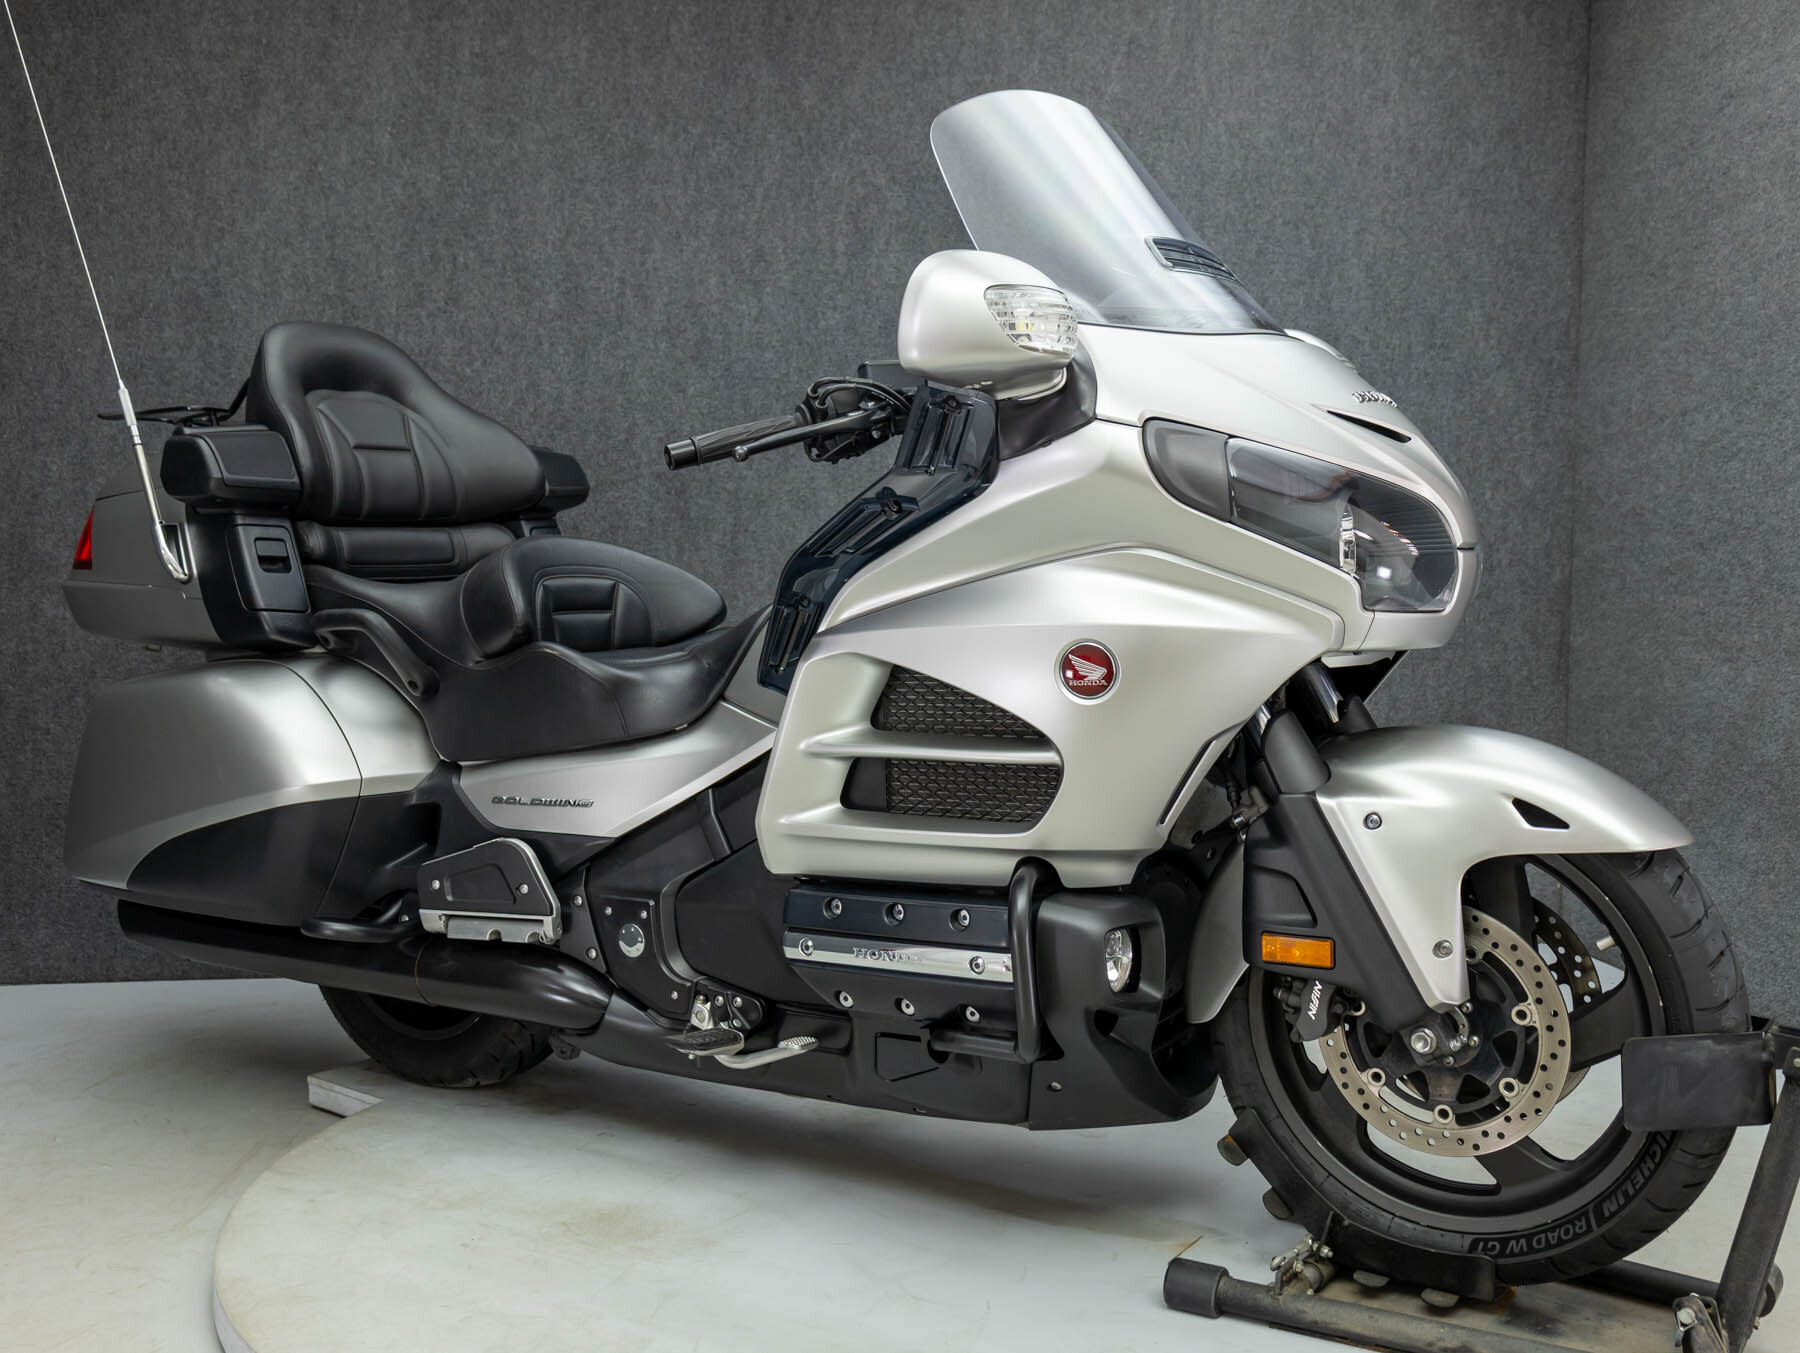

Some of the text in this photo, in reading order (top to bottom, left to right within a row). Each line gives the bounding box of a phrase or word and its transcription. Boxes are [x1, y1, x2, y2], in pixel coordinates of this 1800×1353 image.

[1602, 1132, 1670, 1217] ICHELIN
[1506, 1238, 1530, 1256] W
[1532, 1218, 1588, 1248] ROAD
